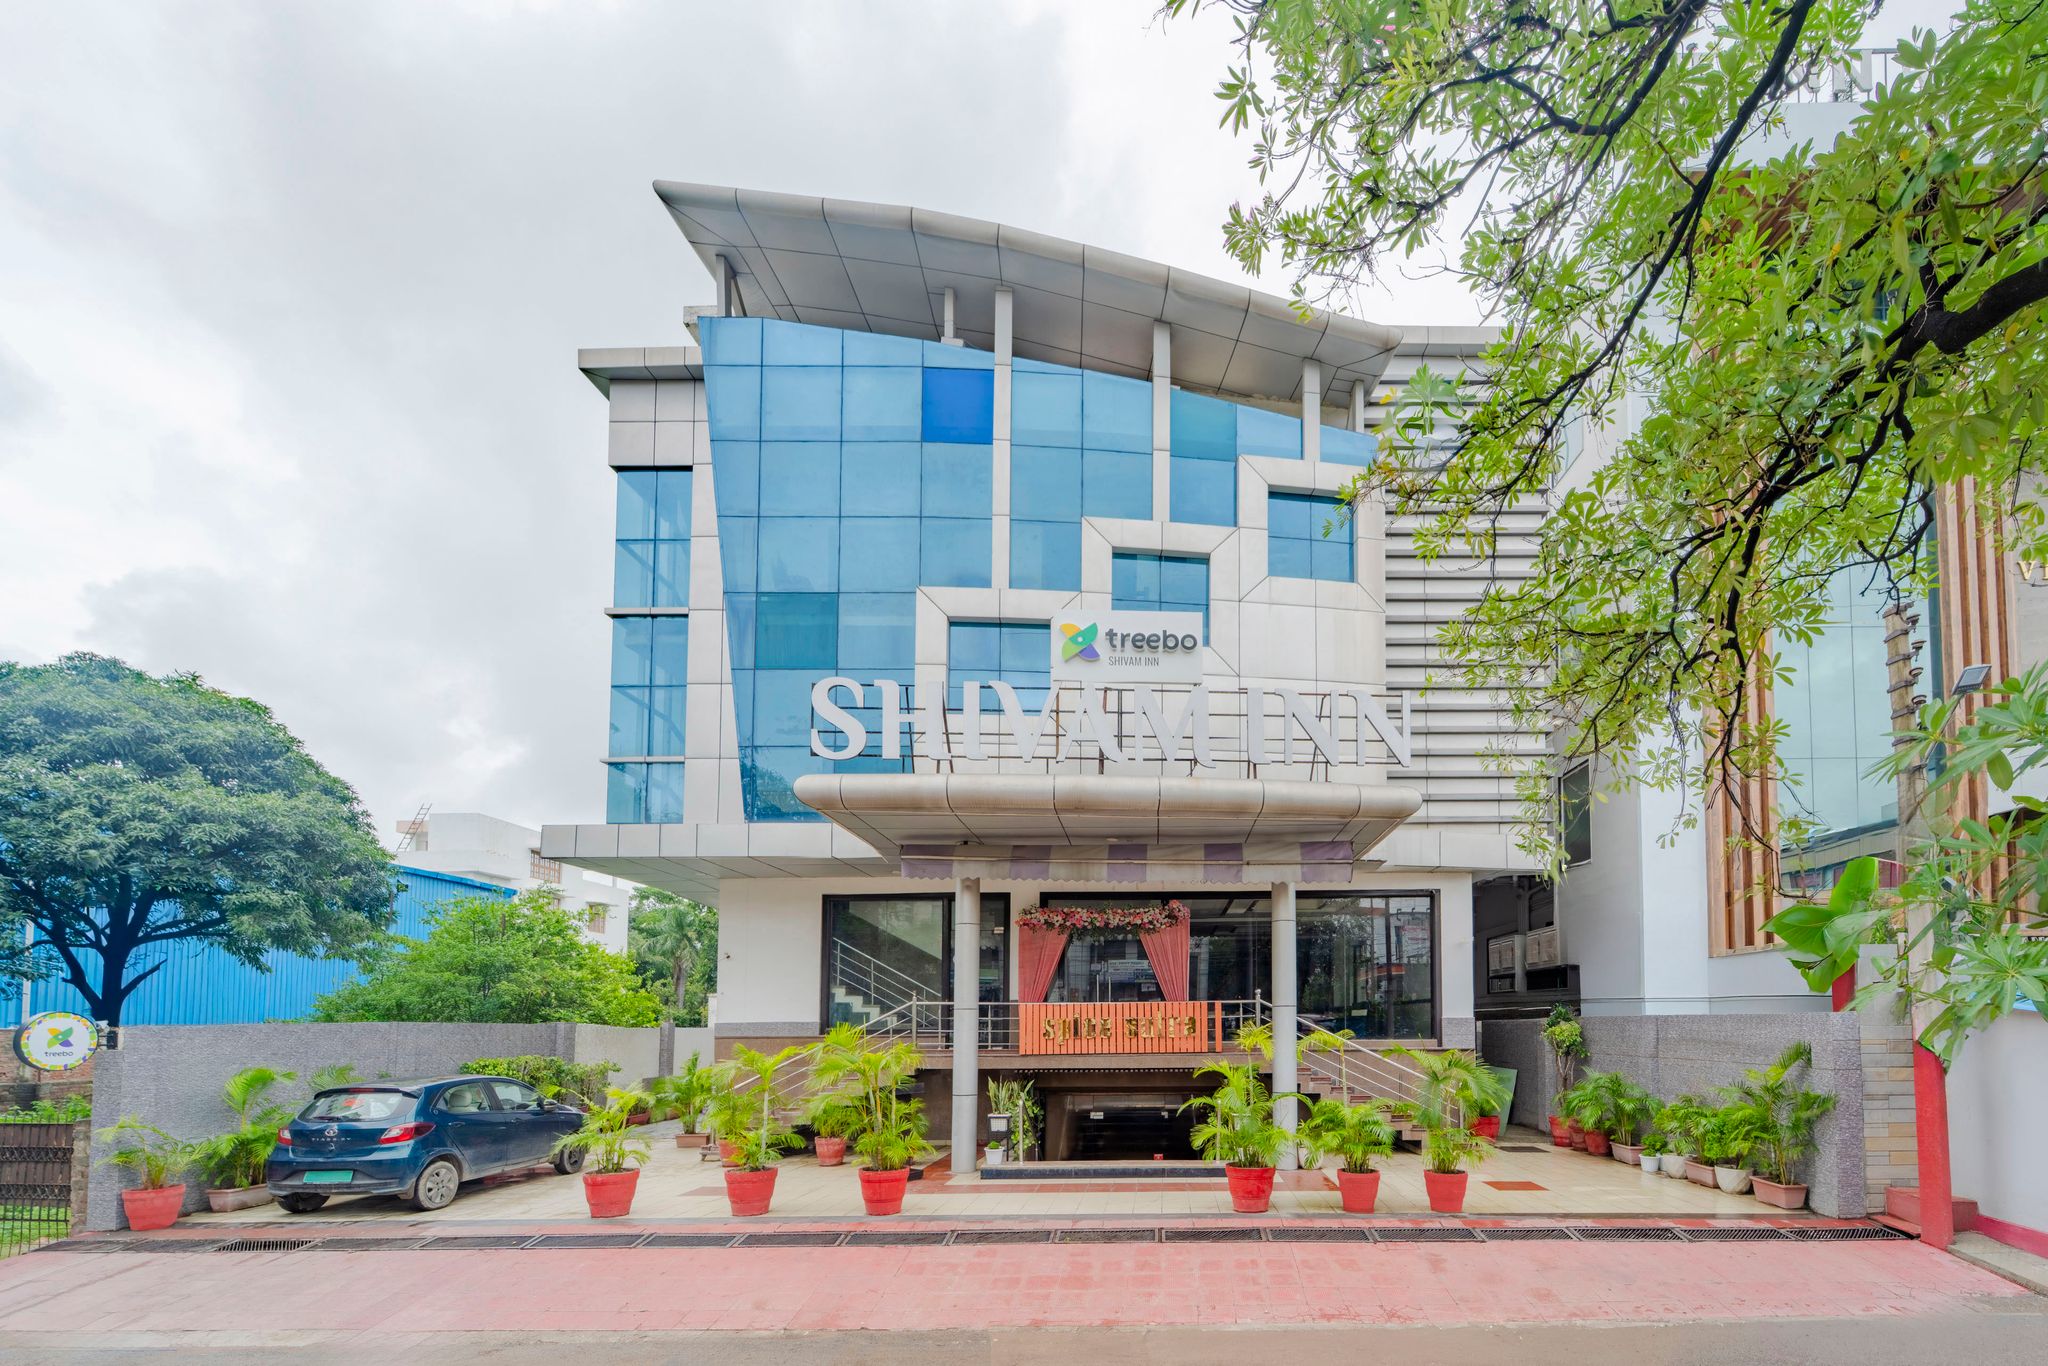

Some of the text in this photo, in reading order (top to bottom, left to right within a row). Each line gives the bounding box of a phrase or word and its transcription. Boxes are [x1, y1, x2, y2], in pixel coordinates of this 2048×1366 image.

[1105, 628, 1198, 652] treebo
[1108, 655, 1160, 667] SHIVAM INN
[810, 675, 1412, 769] SHIVAM INN
[1042, 1010, 1197, 1046] spice sutra
